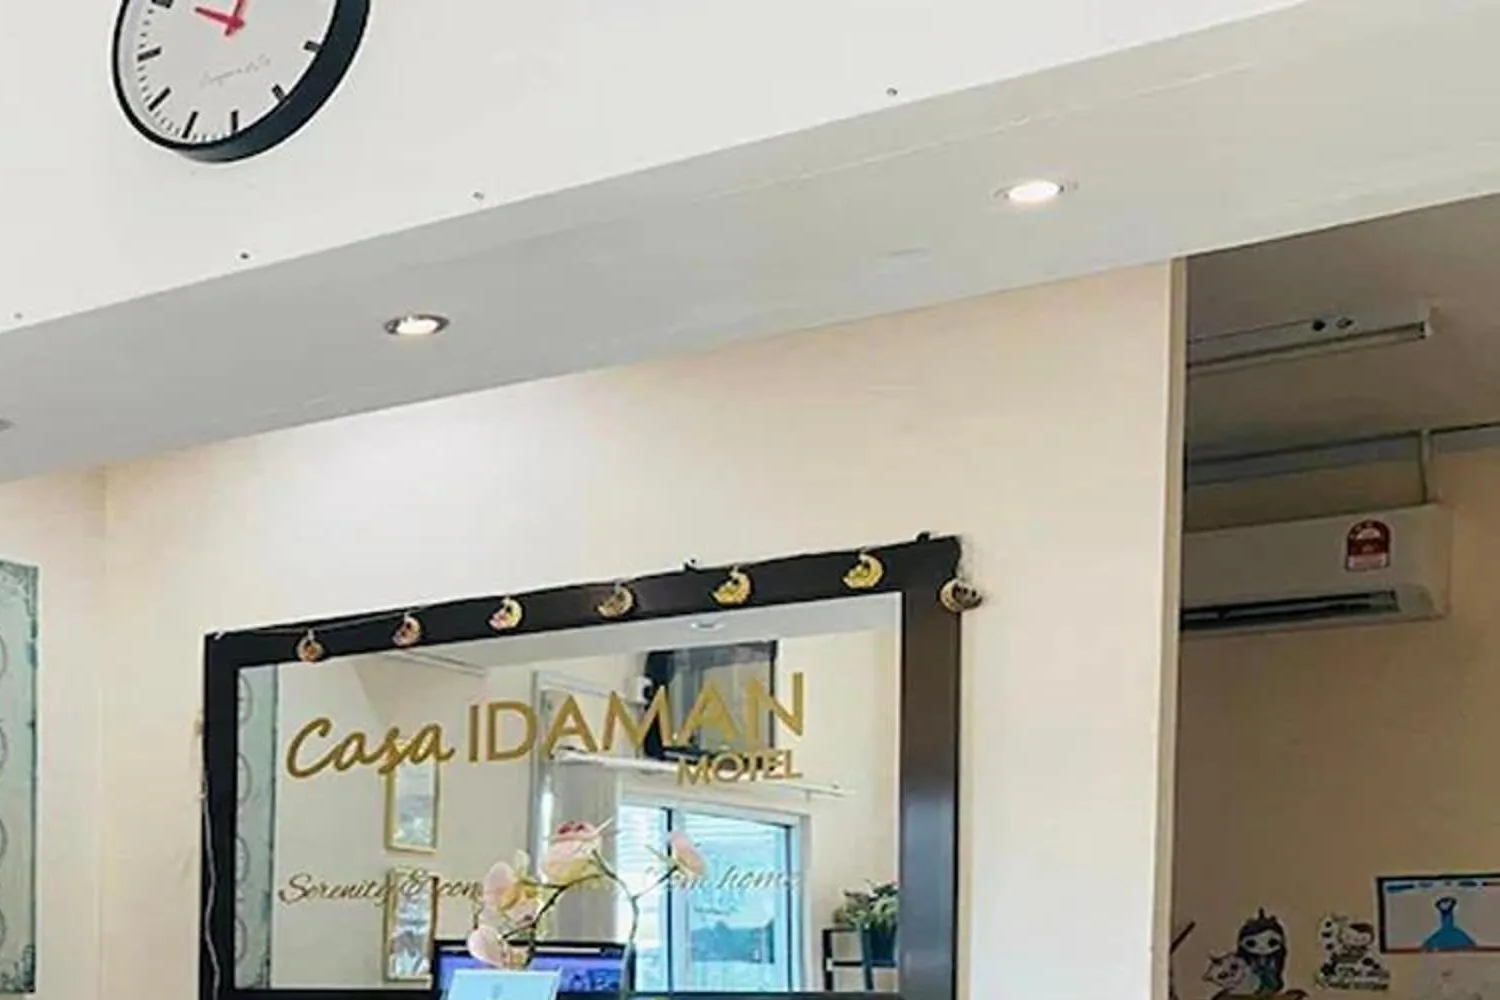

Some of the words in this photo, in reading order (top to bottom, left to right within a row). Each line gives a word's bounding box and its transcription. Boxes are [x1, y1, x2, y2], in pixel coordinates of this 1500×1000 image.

[286, 717, 455, 779] Casa
[468, 671, 804, 763] IDAMAN
[676, 749, 803, 785] MOTEL
[278, 871, 393, 907] Serenity
